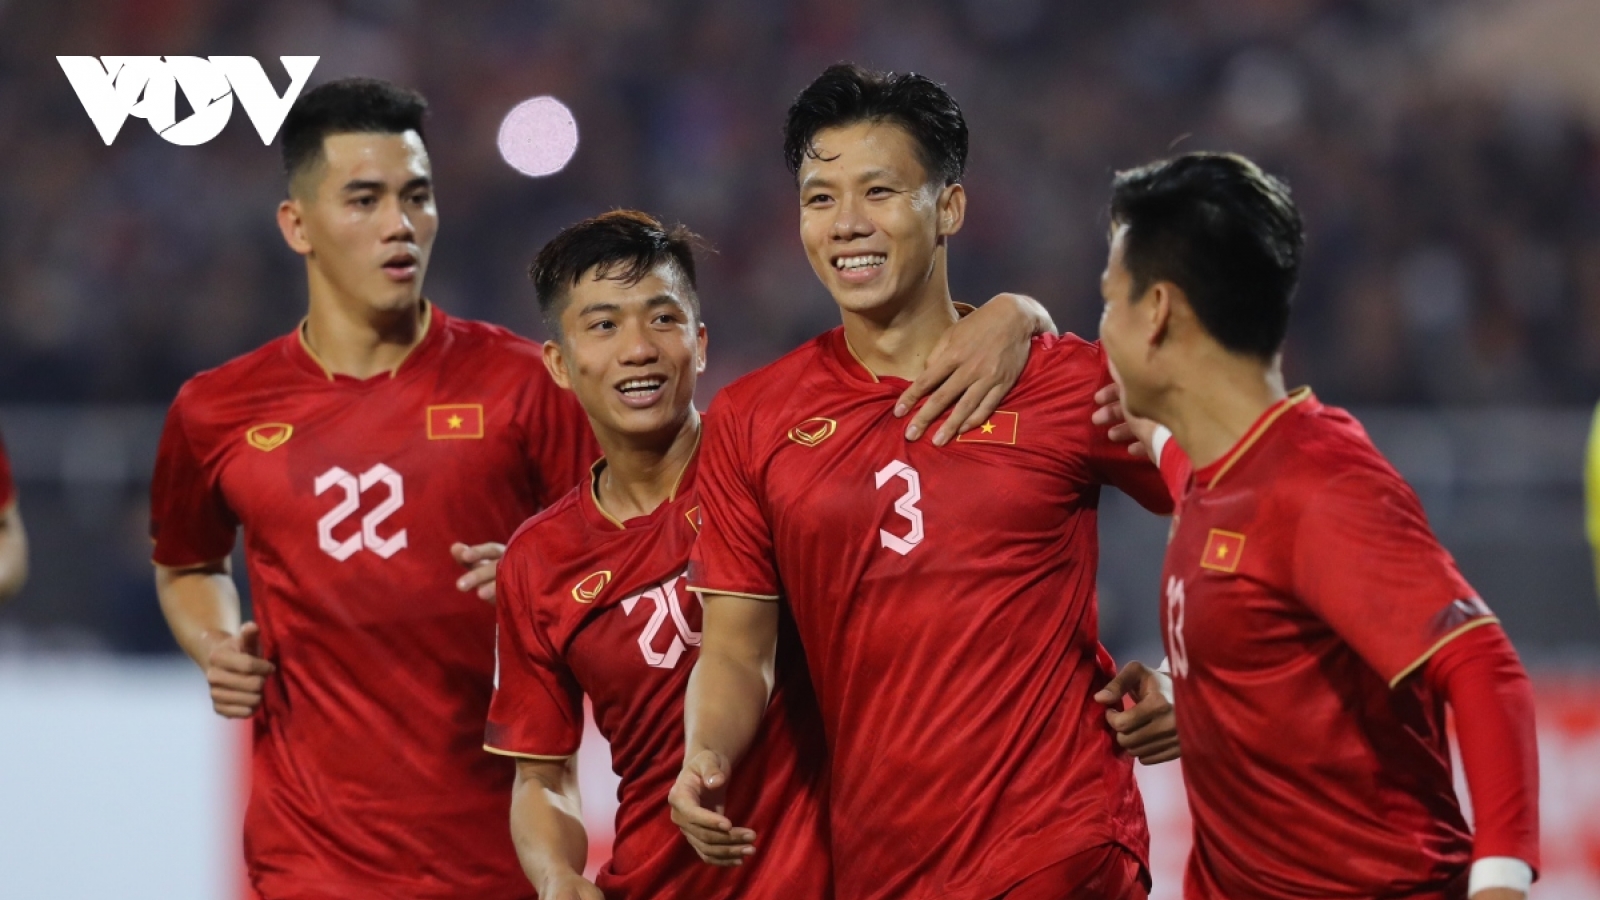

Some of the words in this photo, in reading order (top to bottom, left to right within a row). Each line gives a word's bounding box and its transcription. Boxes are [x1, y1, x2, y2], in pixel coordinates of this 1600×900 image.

[314, 463, 407, 562] 22
[875, 459, 924, 556] 3
[1166, 575, 1189, 679] 13
